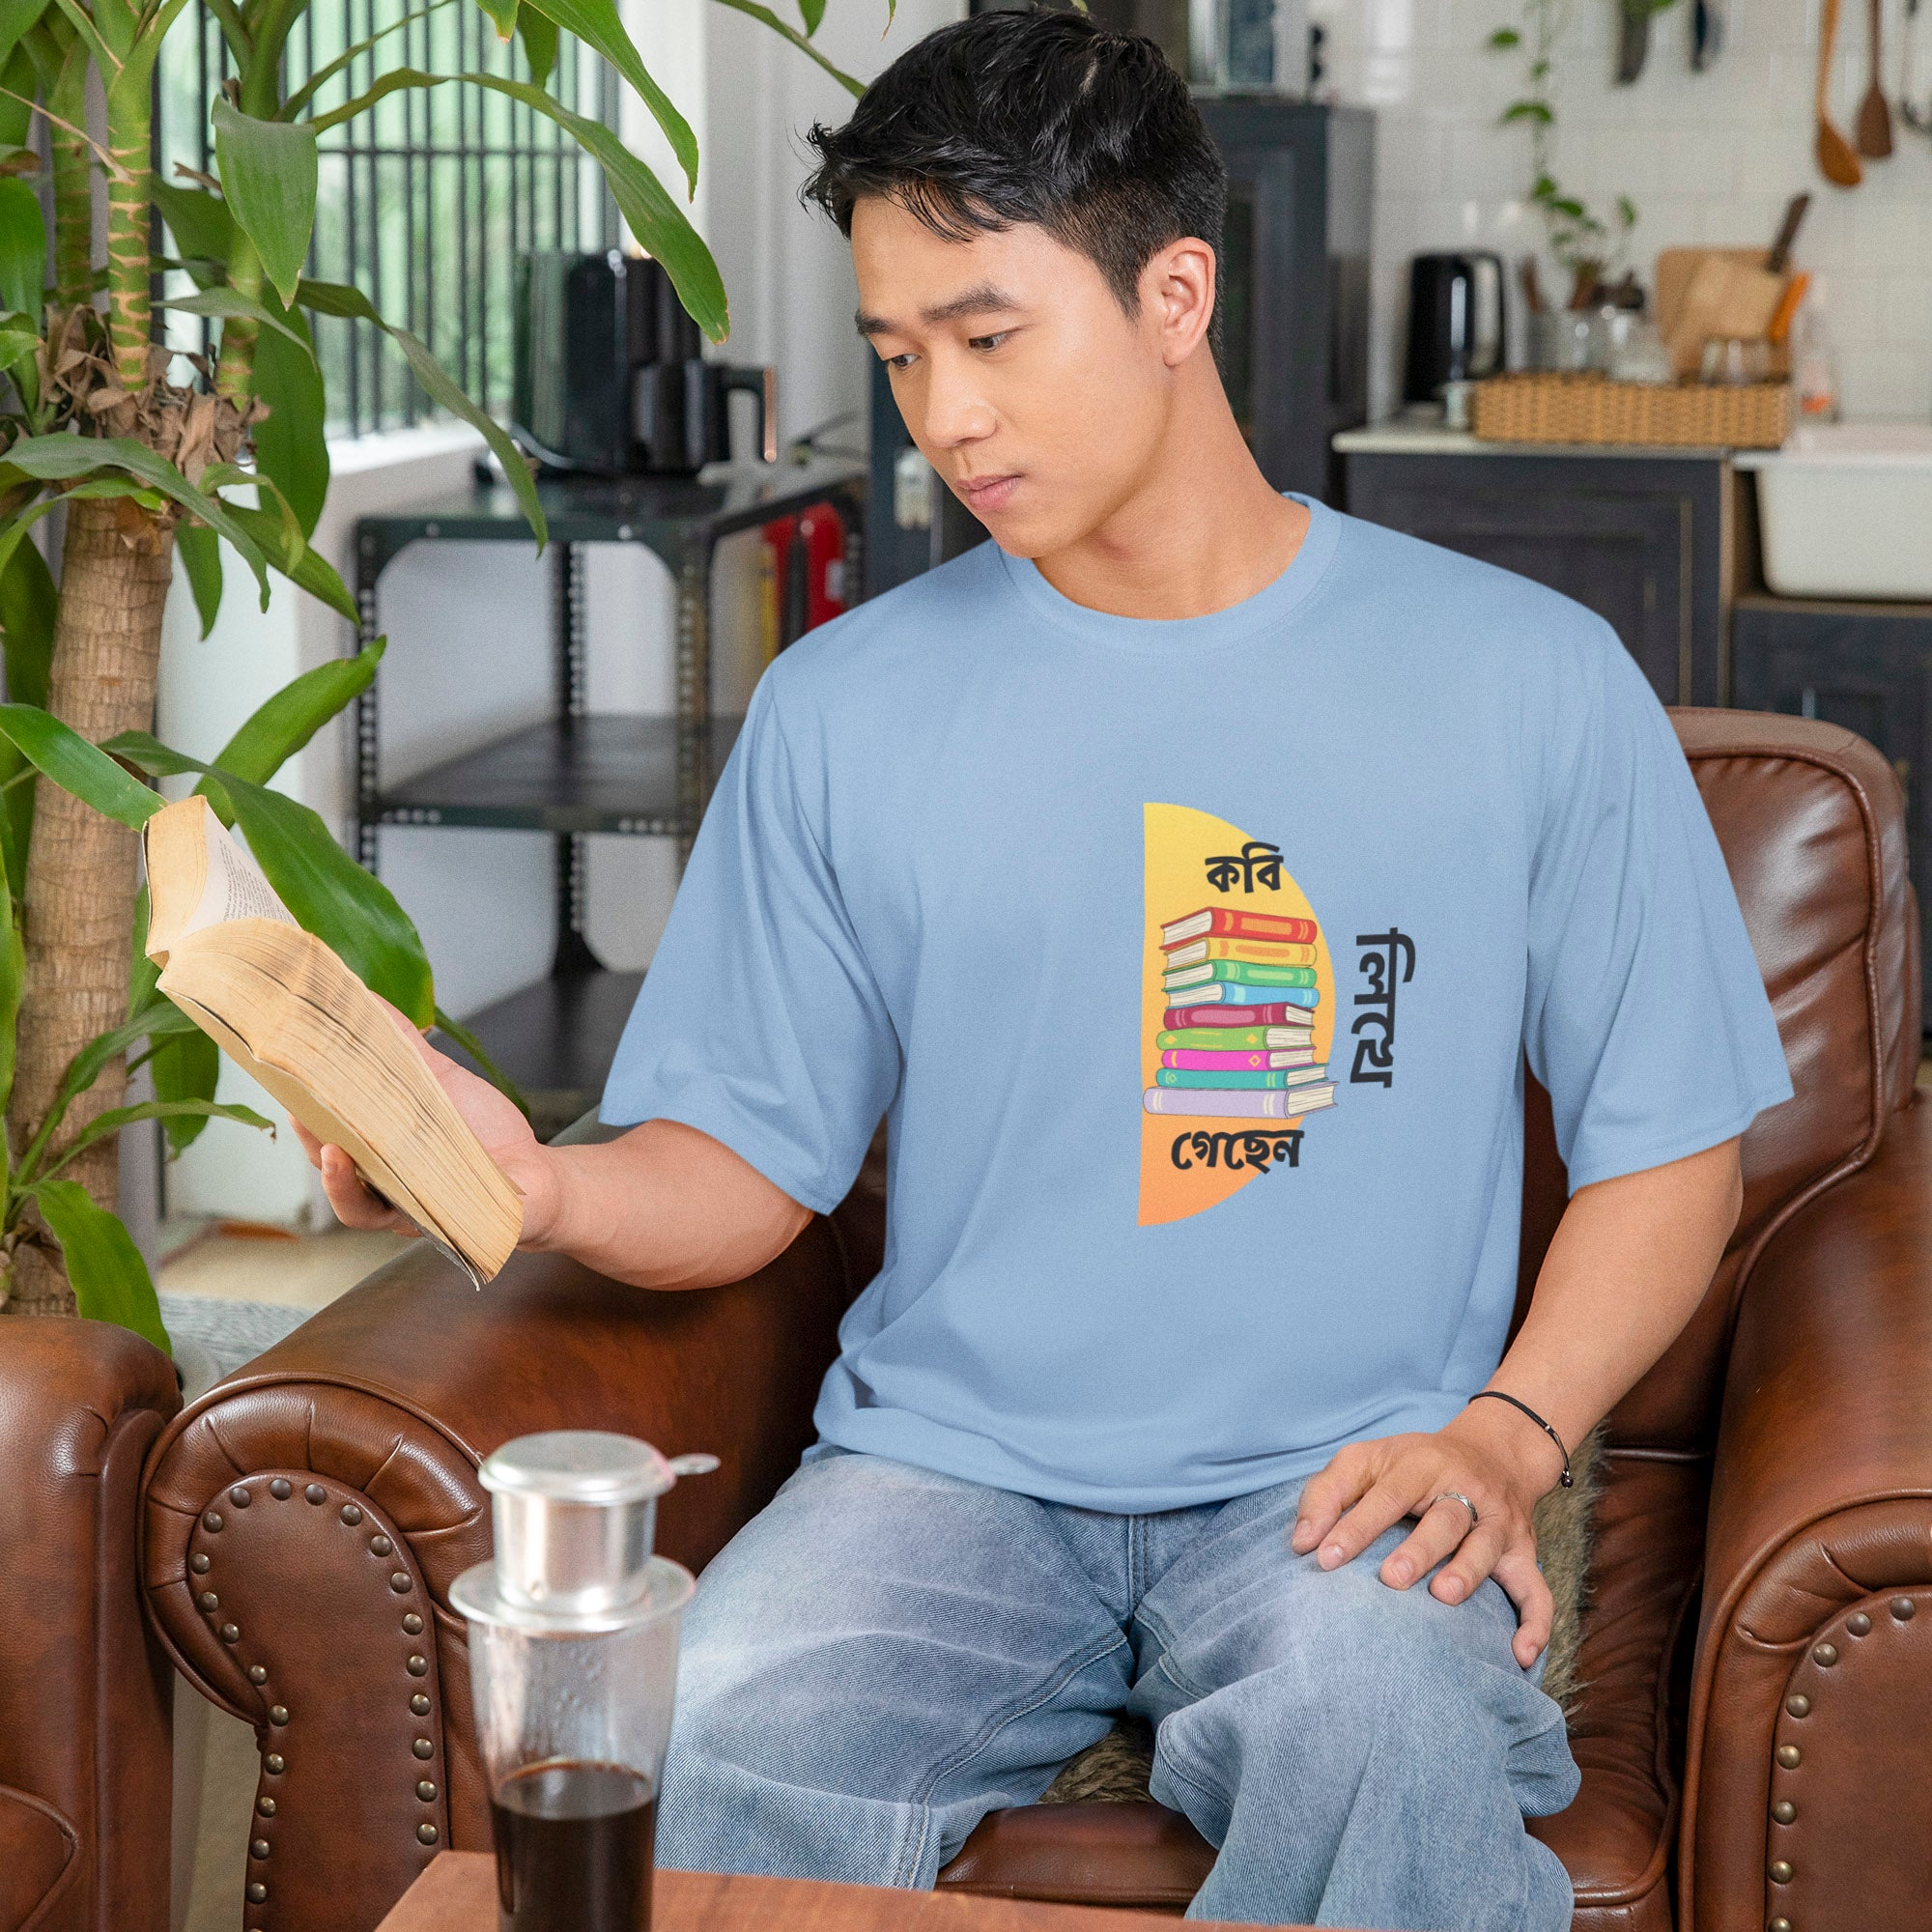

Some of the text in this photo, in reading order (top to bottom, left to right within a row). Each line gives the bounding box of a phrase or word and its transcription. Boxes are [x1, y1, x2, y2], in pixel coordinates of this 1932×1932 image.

[1206, 841, 1283, 893] কবি
[1350, 927, 1416, 1089] লিখে
[1171, 1129, 1304, 1174] গেছেন
